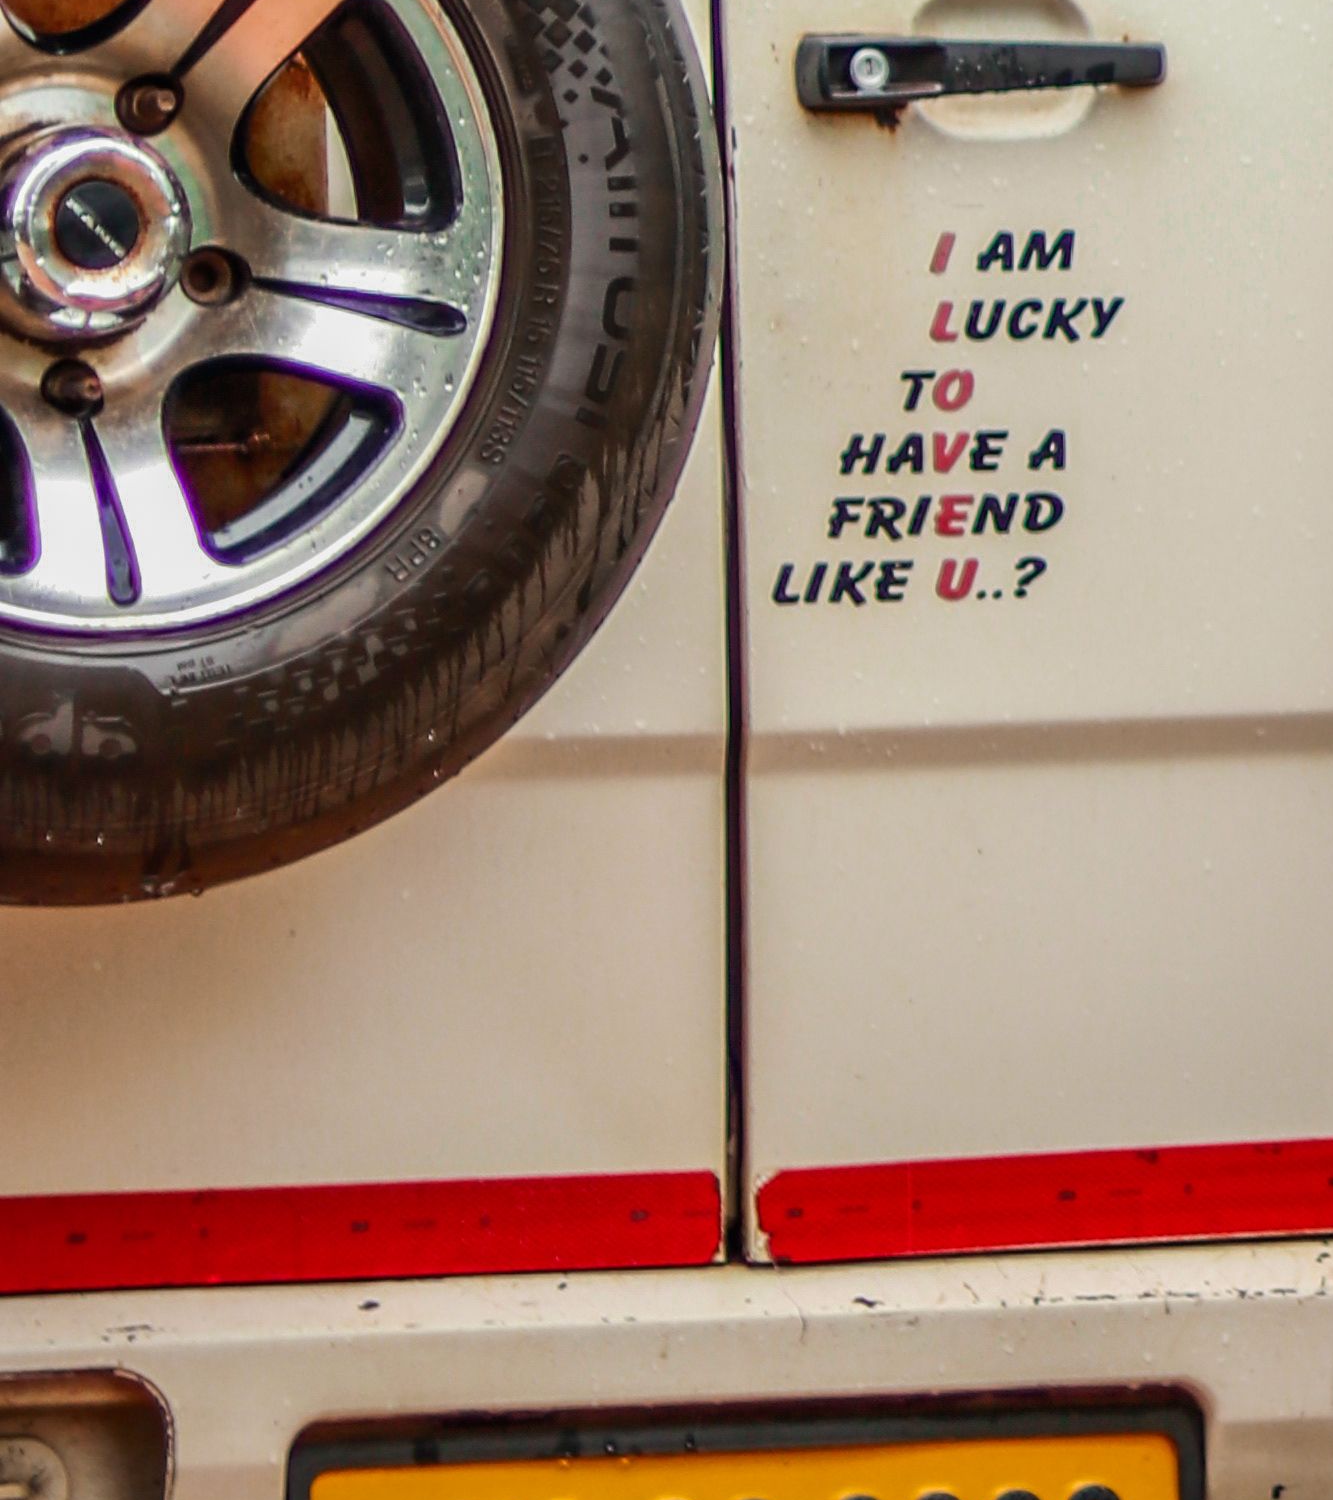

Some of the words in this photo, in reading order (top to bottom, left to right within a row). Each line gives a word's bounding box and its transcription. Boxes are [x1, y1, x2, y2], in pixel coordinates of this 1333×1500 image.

[929, 231, 957, 275] I
[976, 229, 1076, 272] AM
[929, 297, 1125, 343] LUCKY
[900, 368, 976, 413] TO
[839, 430, 1009, 475] HAVE
[1028, 428, 1067, 473] A
[827, 493, 1065, 541] FRIEND
[771, 559, 914, 608] LIKE
